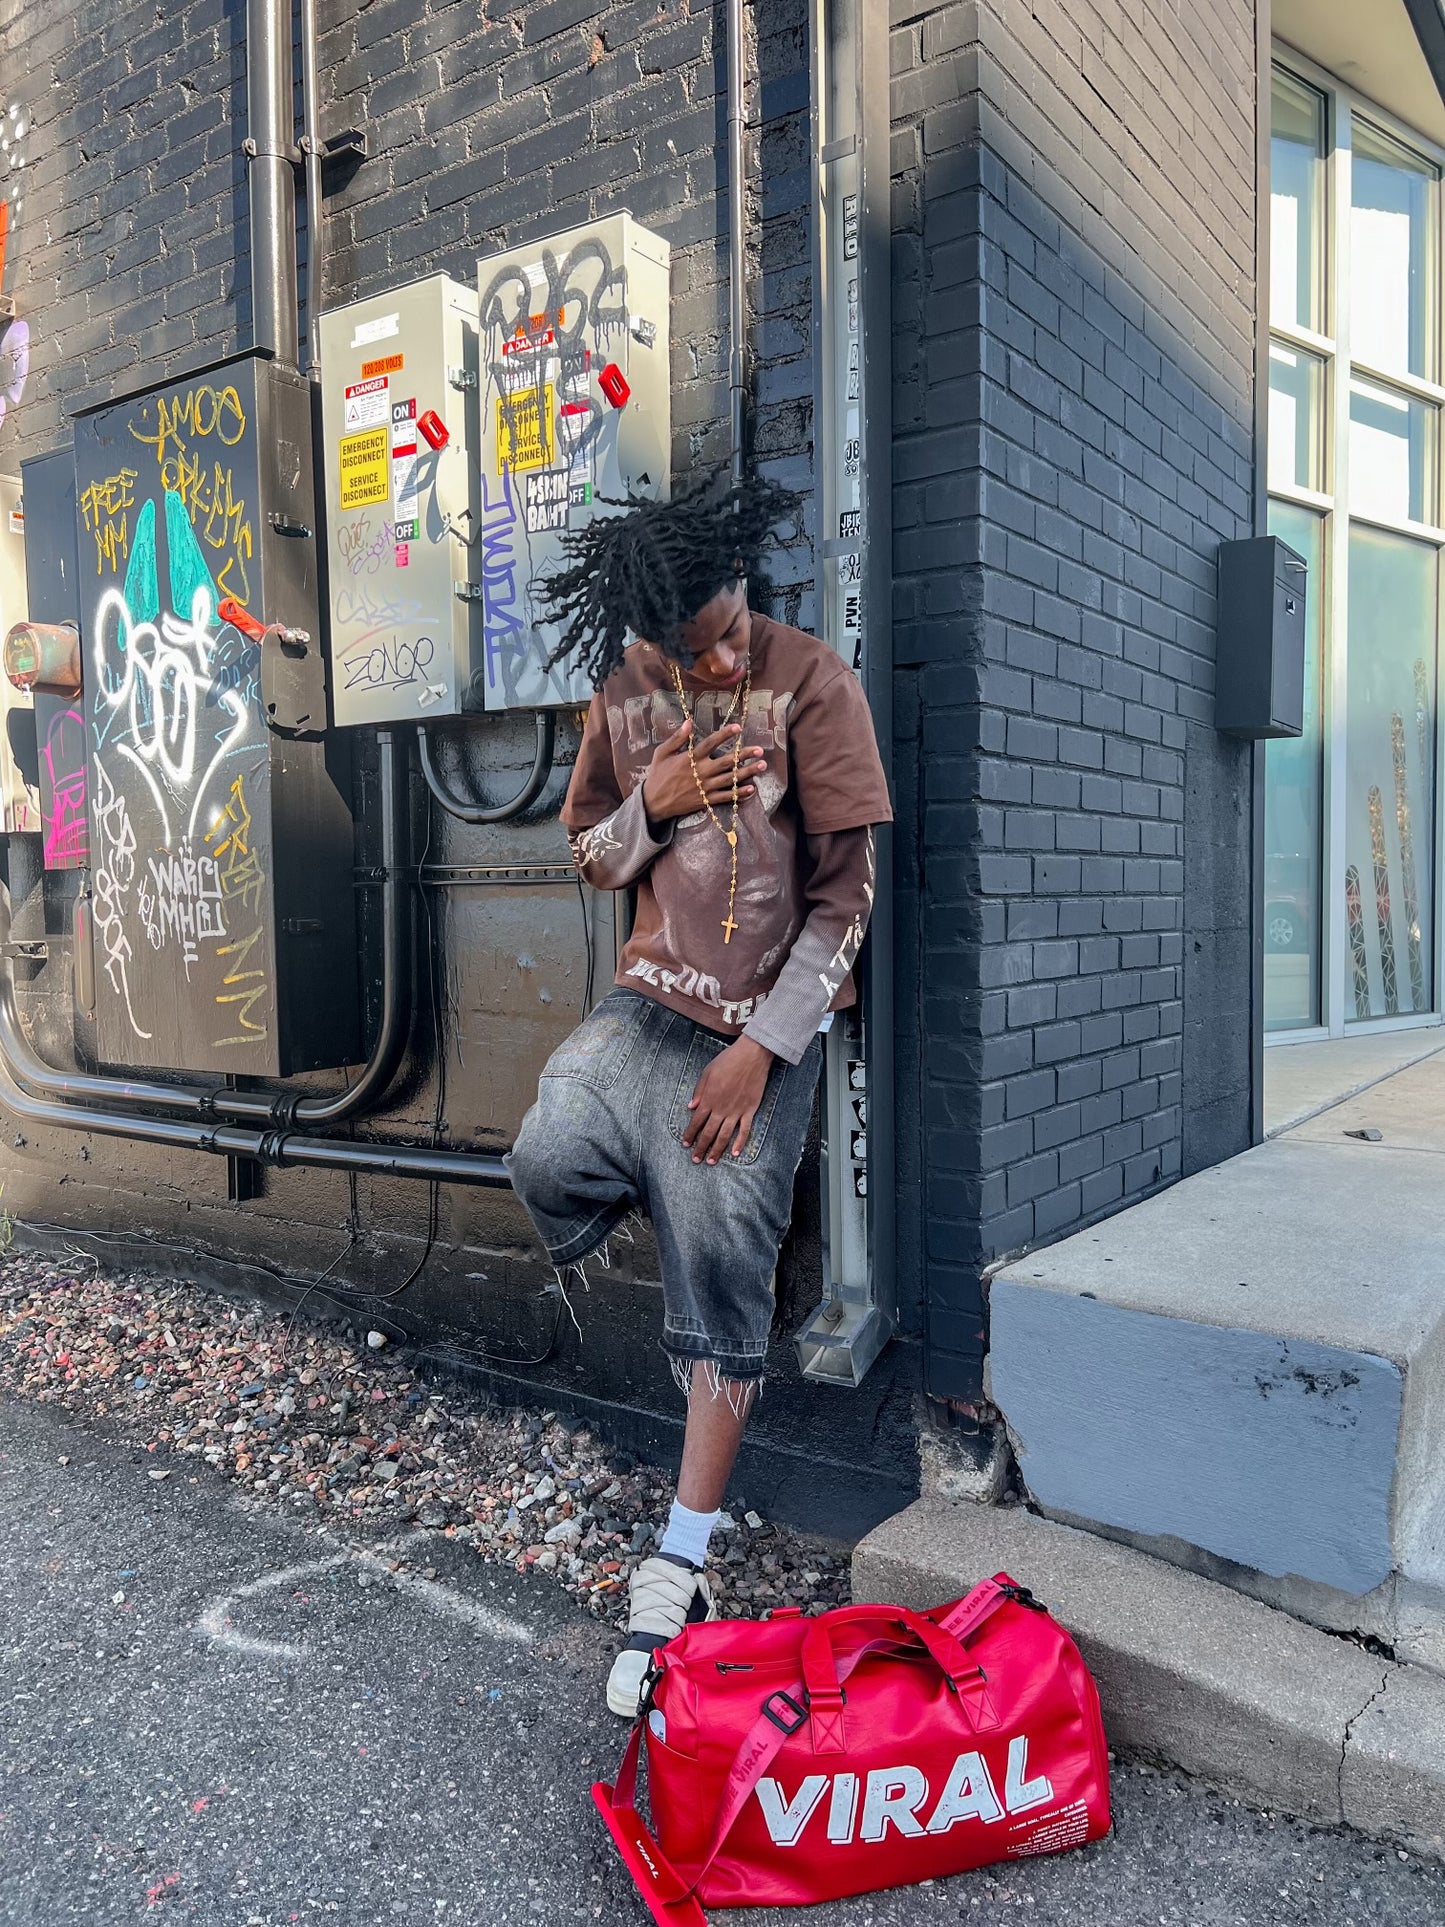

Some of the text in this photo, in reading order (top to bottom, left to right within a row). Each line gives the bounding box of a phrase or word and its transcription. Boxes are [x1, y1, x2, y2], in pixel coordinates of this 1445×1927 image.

[385, 354, 403, 370] VOLTS
[355, 378, 386, 395] DANGER
[393, 404, 409, 420] ON
[342, 436, 385, 456] EMERGENCY
[342, 449, 386, 469] DISCONNECT
[349, 472, 379, 489] SERVICE
[343, 484, 387, 503] DISCONNECT
[395, 523, 414, 540] OFF
[845, 596, 858, 628] PVN
[962, 1583, 996, 1615] VIRAL
[734, 1741, 769, 1784] VIRAL
[754, 1735, 1054, 1847] VIRAL
[636, 1839, 659, 1880] VIRAL
